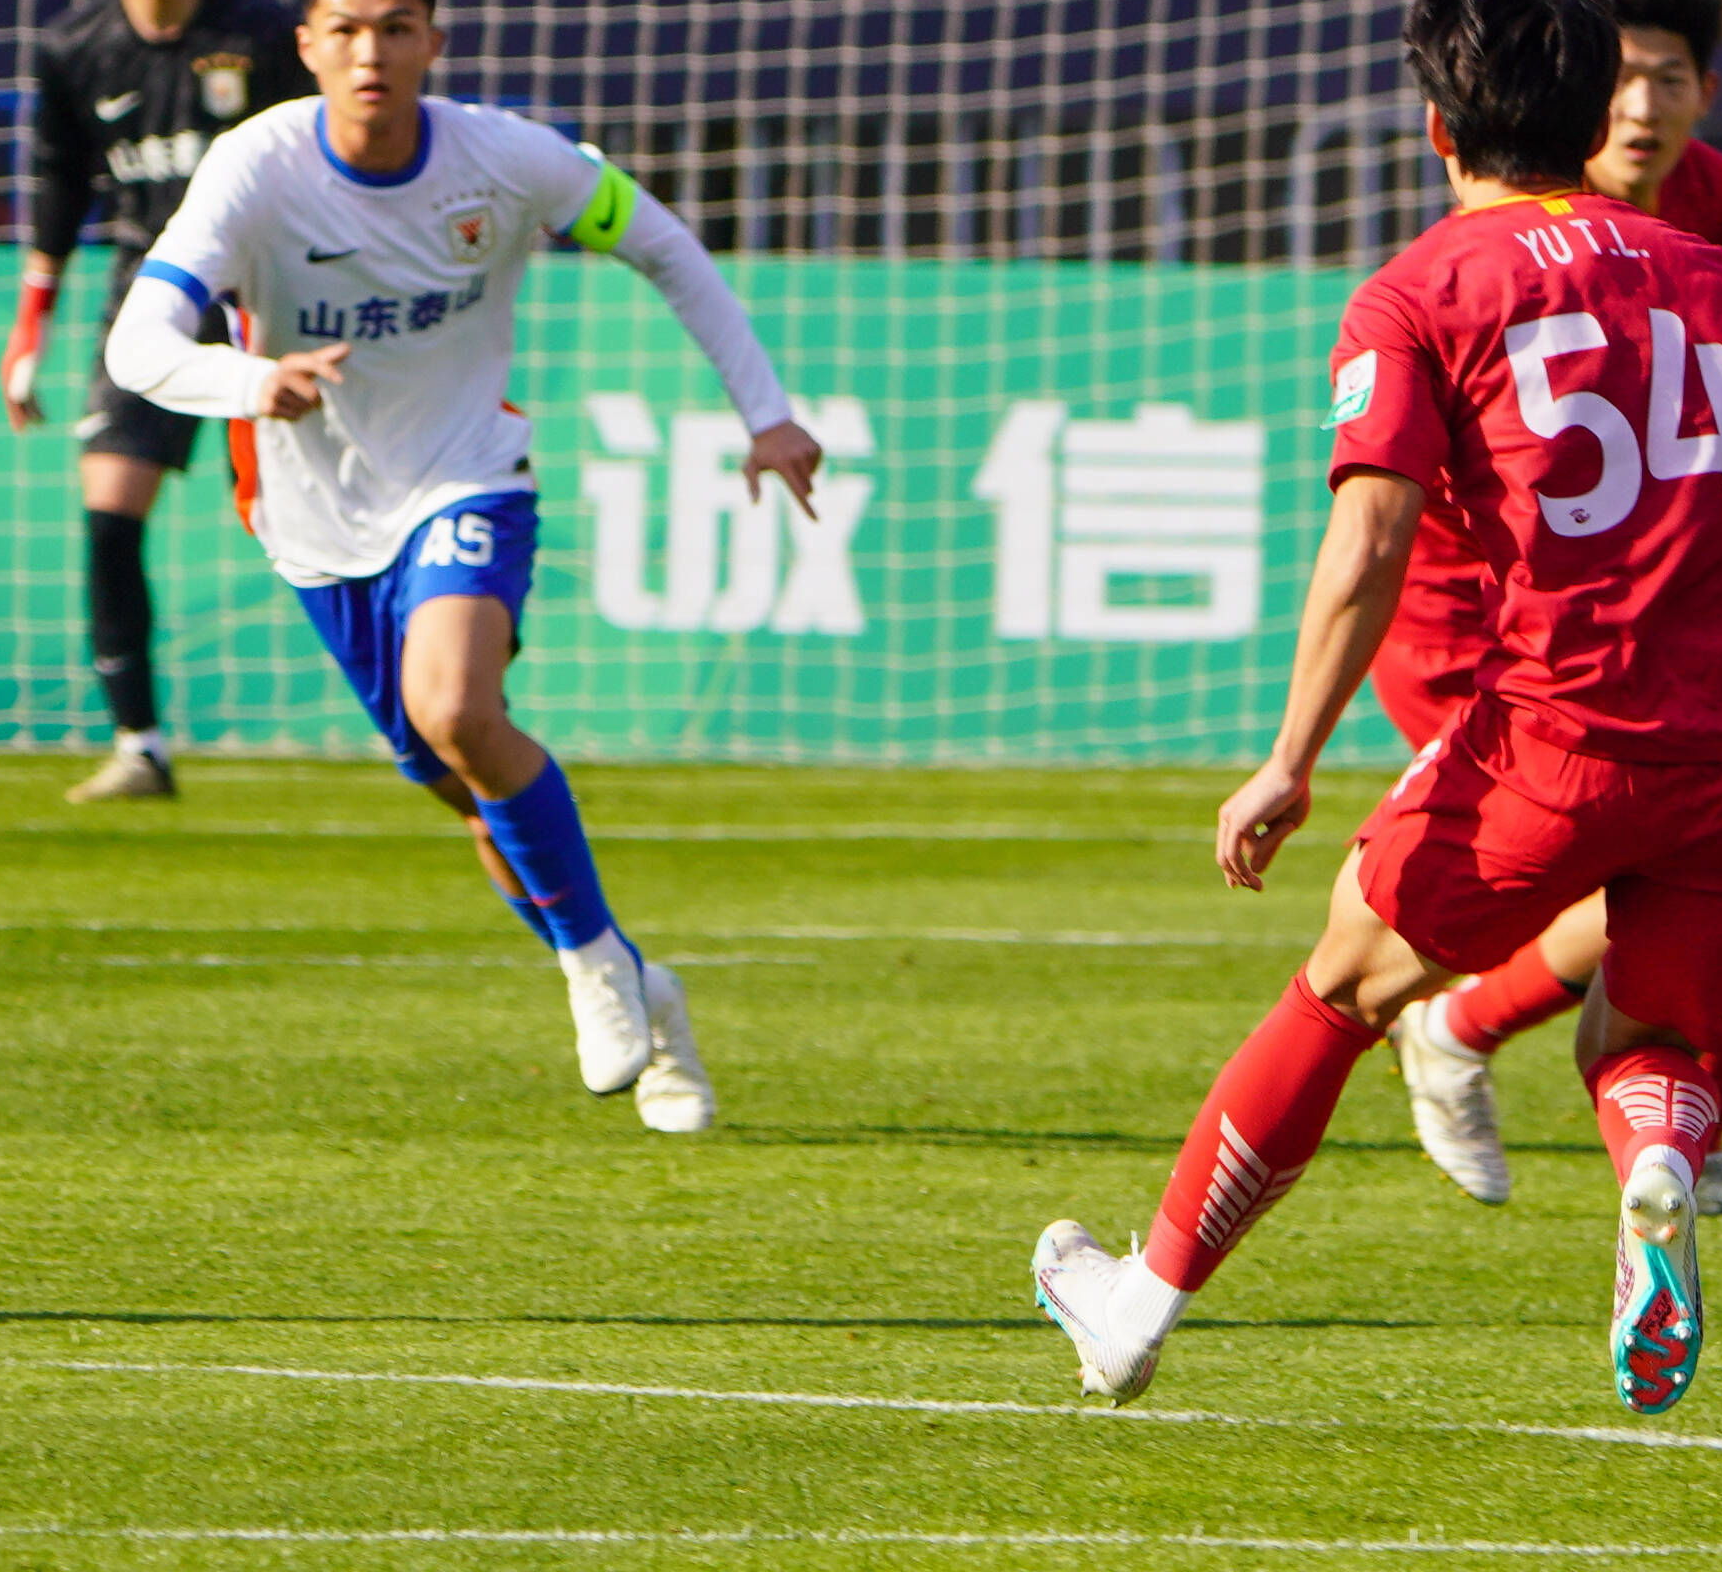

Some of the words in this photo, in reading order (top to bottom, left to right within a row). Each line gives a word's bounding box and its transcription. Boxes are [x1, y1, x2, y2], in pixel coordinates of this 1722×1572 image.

[1512, 223, 1575, 271] YU
[1567, 217, 1652, 260] T.L.
[580, 391, 1269, 642] 诚信
